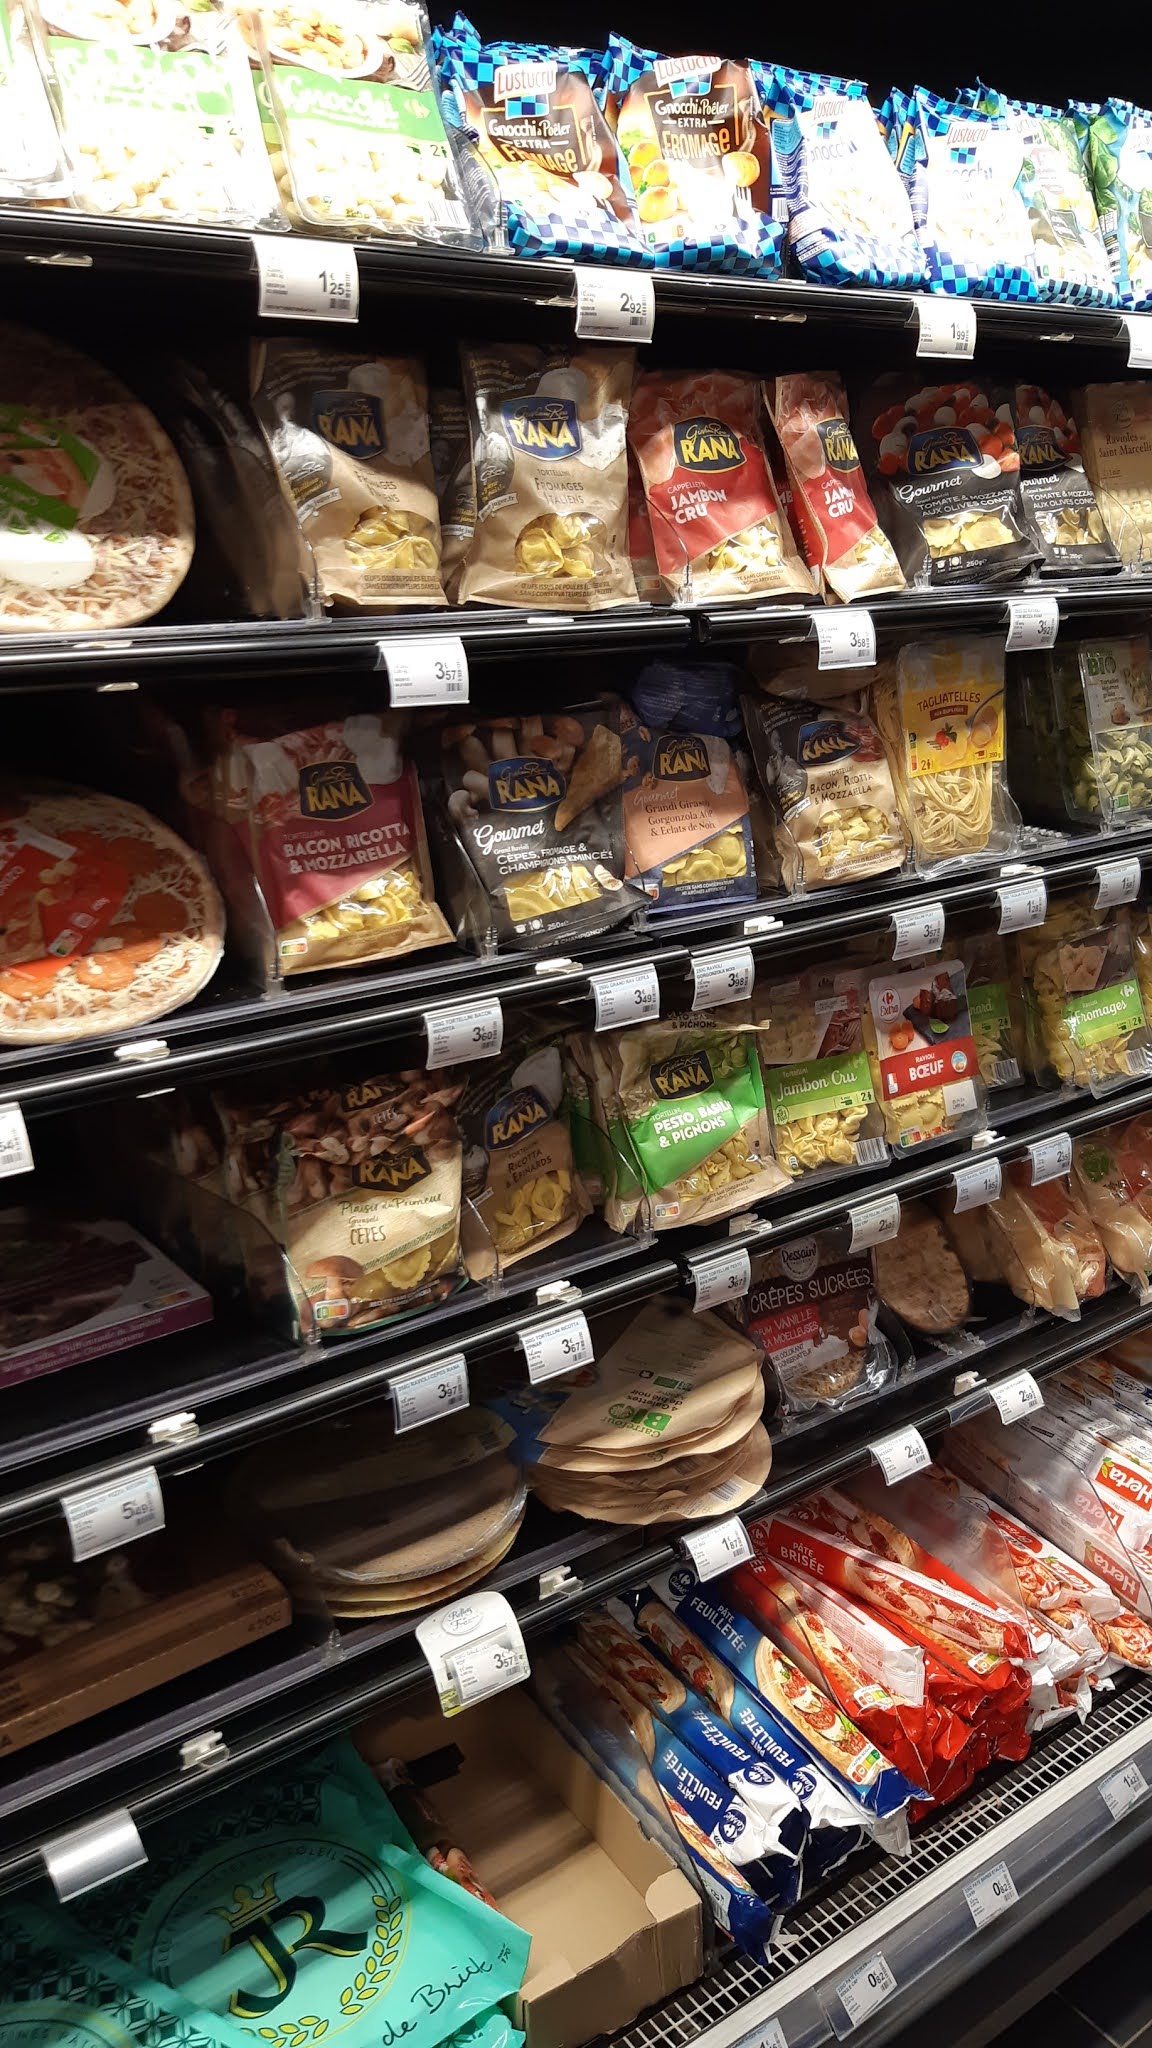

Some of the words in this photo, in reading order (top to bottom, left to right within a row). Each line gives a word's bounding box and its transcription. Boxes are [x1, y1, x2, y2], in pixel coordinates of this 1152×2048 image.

[497, 69, 554, 95] Lustucru
[655, 97, 698, 115] Gnocchi
[700, 98, 730, 116] Poêler
[488, 119, 537, 137] Gnocchi
[539, 120, 571, 137] Poêler
[677, 117, 708, 128] EXTRA
[514, 139, 552, 149] EXTRA
[947, 126, 989, 145] Lustucru
[508, 418, 577, 449] RANA
[680, 436, 740, 464] RANA
[825, 439, 859, 465] RANA
[914, 444, 976, 472] RANA
[1019, 443, 1065, 465] RANA
[534, 477, 584, 492] FROMAGES
[897, 475, 962, 504] Gourmet
[1028, 491, 1061, 501] TOMATE
[1061, 490, 1068, 498] &
[671, 489, 728, 511] JAMBON
[828, 499, 854, 518] CRU
[919, 495, 960, 511] TOMATE
[961, 493, 968, 502] &
[922, 506, 943, 517] AUX
[944, 500, 979, 512] OLIVES
[1033, 500, 1049, 509] AUX
[673, 505, 708, 525] CRU
[1087, 656, 1117, 676] BIO
[917, 691, 981, 712] TAGLIATELLES
[802, 736, 856, 761] RANA
[660, 749, 709, 776] RANA
[306, 781, 367, 812] RANA
[495, 775, 560, 804] RANA
[645, 800, 678, 814] Grandi
[648, 811, 698, 826] Gorgonzola
[346, 823, 410, 848] RICOTTA
[473, 819, 545, 856] Gourmet
[650, 828, 658, 837] &
[688, 822, 698, 832] de
[289, 860, 304, 875] &
[304, 841, 407, 872] MOZZARELLA
[578, 843, 588, 852] &
[880, 1004, 899, 1017] Extra
[1074, 1000, 1128, 1025] Fromages
[655, 1065, 710, 1096] RANA
[777, 1077, 829, 1102] Jambon
[831, 1069, 858, 1086] Cru
[861, 1092, 866, 1102] 2
[492, 1101, 549, 1145] RANA
[658, 1135, 671, 1149] &
[671, 1116, 726, 1145] PIGNONS
[359, 1156, 427, 1187] RANA
[750, 1284, 805, 1315] CRÊPES
[808, 1266, 871, 1299] SUCRÉES
[773, 1308, 813, 1331] VANILLE
[774, 1321, 819, 1347] MOELLEUSES
[600, 1415, 661, 1438] Carrefour
[780, 1546, 826, 1576] BRISÉE
[792, 1541, 815, 1558] PÂTE
[1094, 1552, 1138, 1599] Herta
[689, 1596, 747, 1654] FEUILLETÉE
[717, 1604, 735, 1624] PÂTE
[693, 1709, 752, 1762] FEUILLETÉE
[738, 1707, 796, 1768] FEUILLETÉE
[750, 1738, 766, 1757] PÂTE
[662, 1749, 724, 1811] FEUILLETÉE
[677, 1782, 696, 1802] PÂTE
[410, 1957, 493, 2015] Brick
[382, 2020, 418, 2046] de
